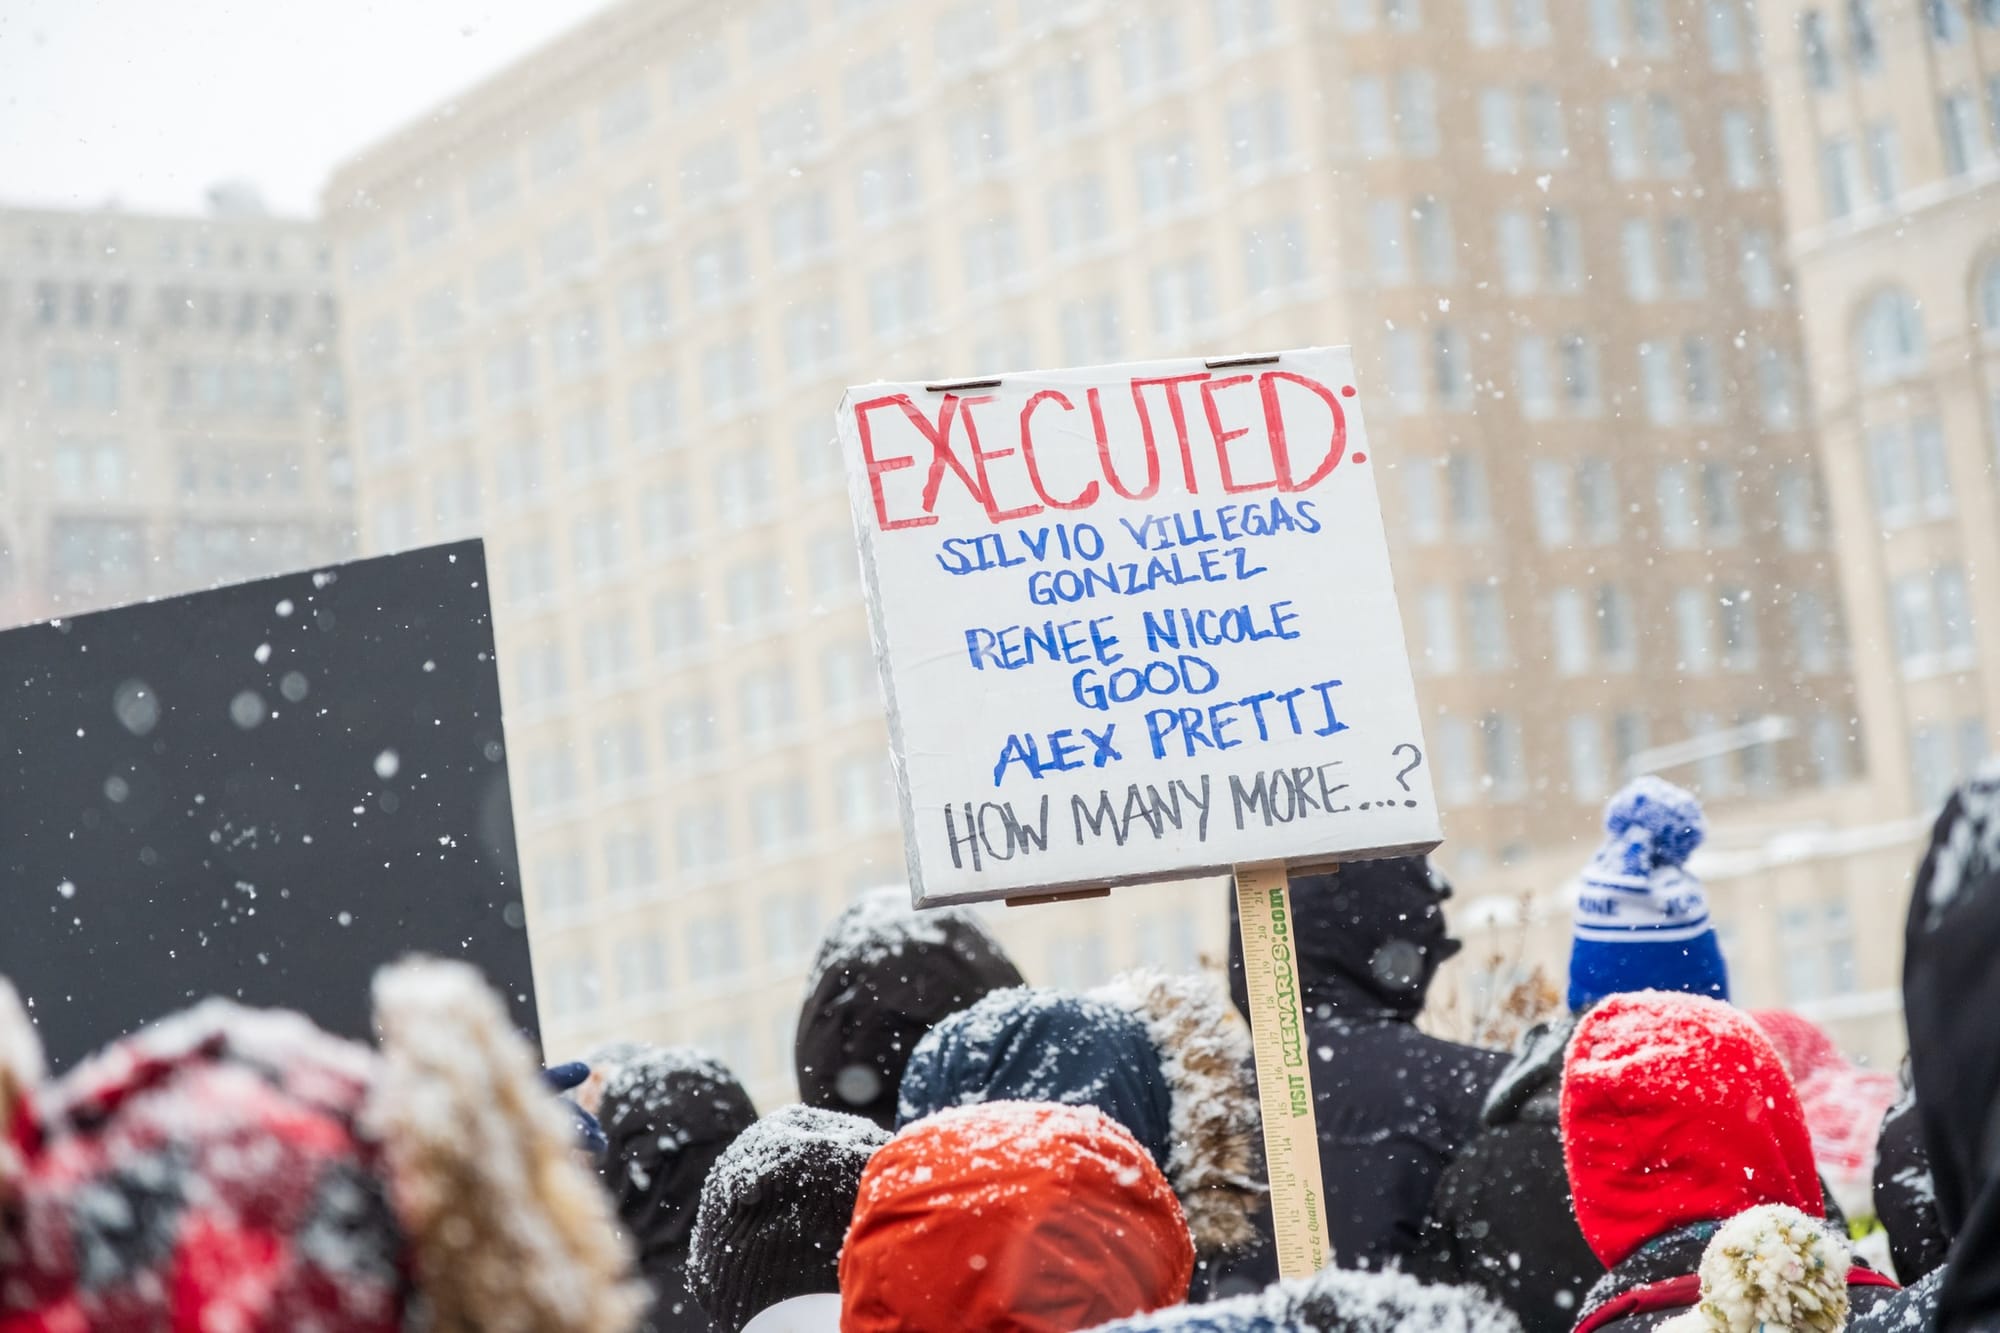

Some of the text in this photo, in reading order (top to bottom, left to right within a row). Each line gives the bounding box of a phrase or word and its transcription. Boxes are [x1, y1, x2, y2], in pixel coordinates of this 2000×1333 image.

[855, 372, 1366, 530] EXECUTED:
[936, 497, 1321, 577] SILVIO VILLEGAS
[1028, 547, 1267, 605] GONZALEZ
[965, 601, 1300, 673] RENEE NICOLE
[1072, 655, 1219, 711] GOOD
[994, 680, 1349, 787] ALEX PRETTI
[944, 795, 1048, 871] HOW
[1071, 775, 1209, 846] MANY
[1254, 891, 1264, 904] 21
[1258, 926, 1267, 939] 20
[1263, 961, 1272, 974] 19
[1270, 1032, 1279, 1044] 17
[1274, 1067, 1284, 1081] 16
[1280, 1102, 1288, 1115] 15
[1288, 1074, 1308, 1118] VISIT
[1282, 1137, 1292, 1152] 14
[1287, 1173, 1296, 1187] 13
[1311, 1248, 1322, 1273] vice
